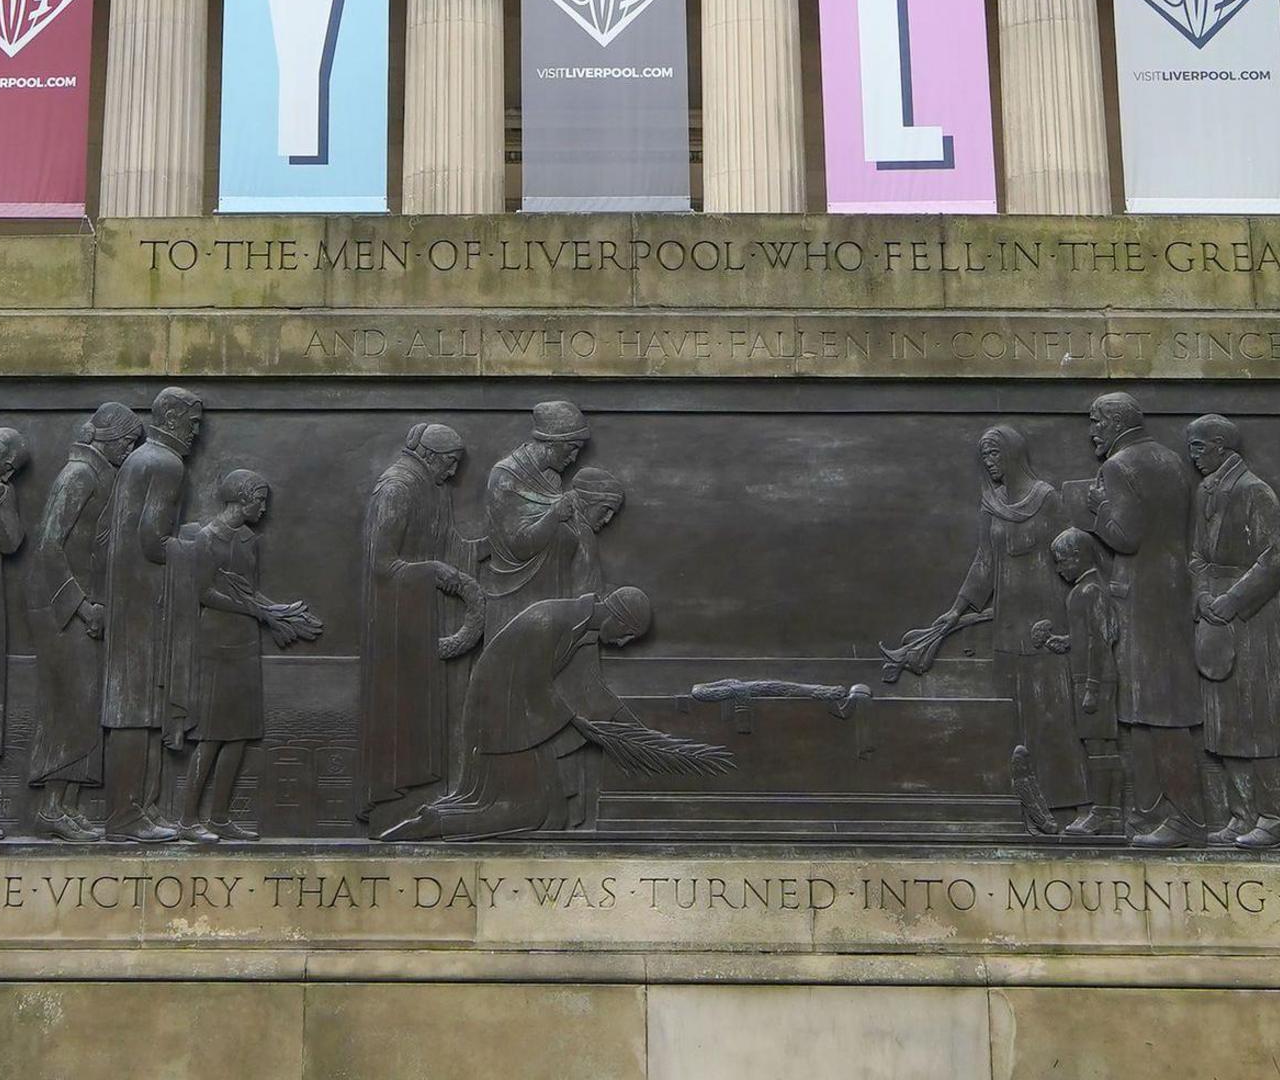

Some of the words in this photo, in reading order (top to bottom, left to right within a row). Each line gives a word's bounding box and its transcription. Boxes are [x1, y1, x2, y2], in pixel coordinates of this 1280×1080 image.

[536, 67, 674, 79] VISITLIVERPOOL.COM
[1133, 71, 1271, 82] VISITLIVERPOOL.COM
[140, 240, 198, 271] TO
[215, 240, 298, 271] THE
[314, 240, 411, 271] MEN
[428, 240, 481, 271] OF
[500, 240, 745, 272] LIVERPOOL
[756, 241, 863, 272] WHO
[885, 241, 986, 272] FELL
[1000, 241, 1042, 272] IN
[1058, 242, 1146, 272] THE
[303, 329, 389, 358] AND
[407, 329, 478, 358] ALL
[496, 330, 598, 359] WHO
[619, 330, 711, 359] HAVE
[730, 331, 871, 360] FALLEN
[889, 331, 928, 360] IN
[951, 331, 1152, 361] CONFLICT
[41, 875, 242, 909] VICTORY
[264, 876, 390, 909] THAT
[414, 876, 504, 910] DAY
[526, 876, 617, 910] WAS
[640, 877, 837, 911] TURNED
[863, 879, 977, 912] INTO
[1007, 879, 1267, 914] MOURNING
